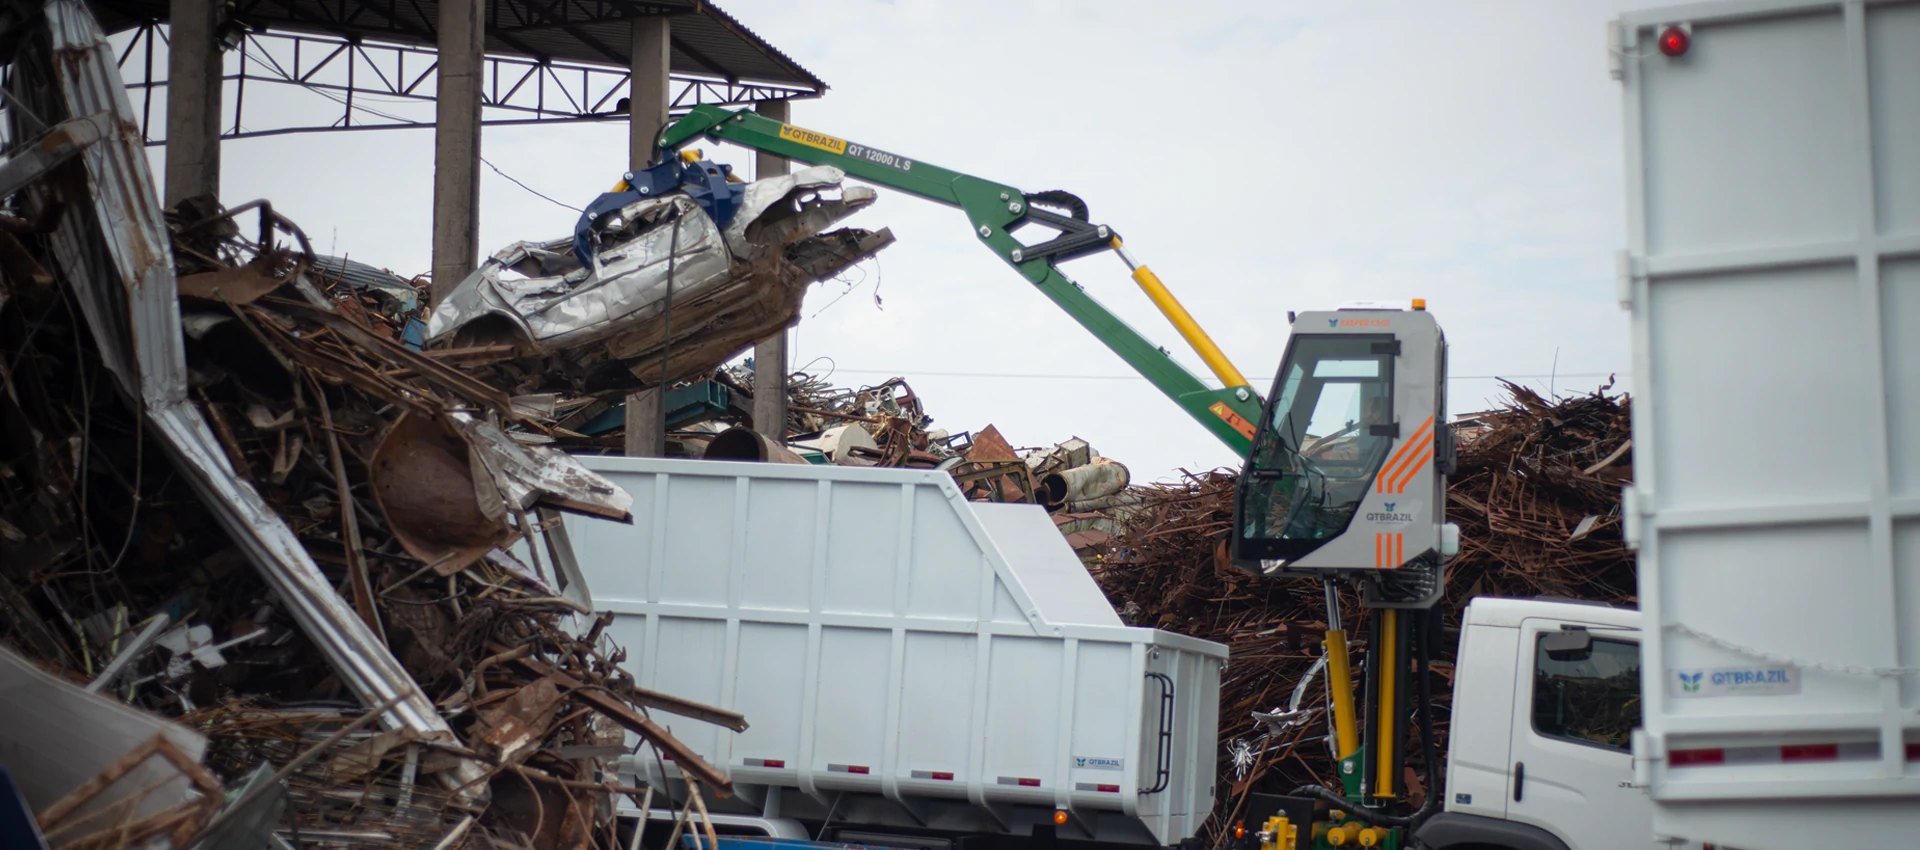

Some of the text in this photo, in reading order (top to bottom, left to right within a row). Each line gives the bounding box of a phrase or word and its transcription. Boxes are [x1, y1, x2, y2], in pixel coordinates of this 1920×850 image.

[792, 129, 842, 151] QTBRAZIL
[848, 144, 912, 171] QT 12000 L S
[1366, 512, 1413, 521] QTBRAZIL
[1711, 670, 1790, 685] QTBRAZIL
[1088, 758, 1120, 767] QTBRAZIL
